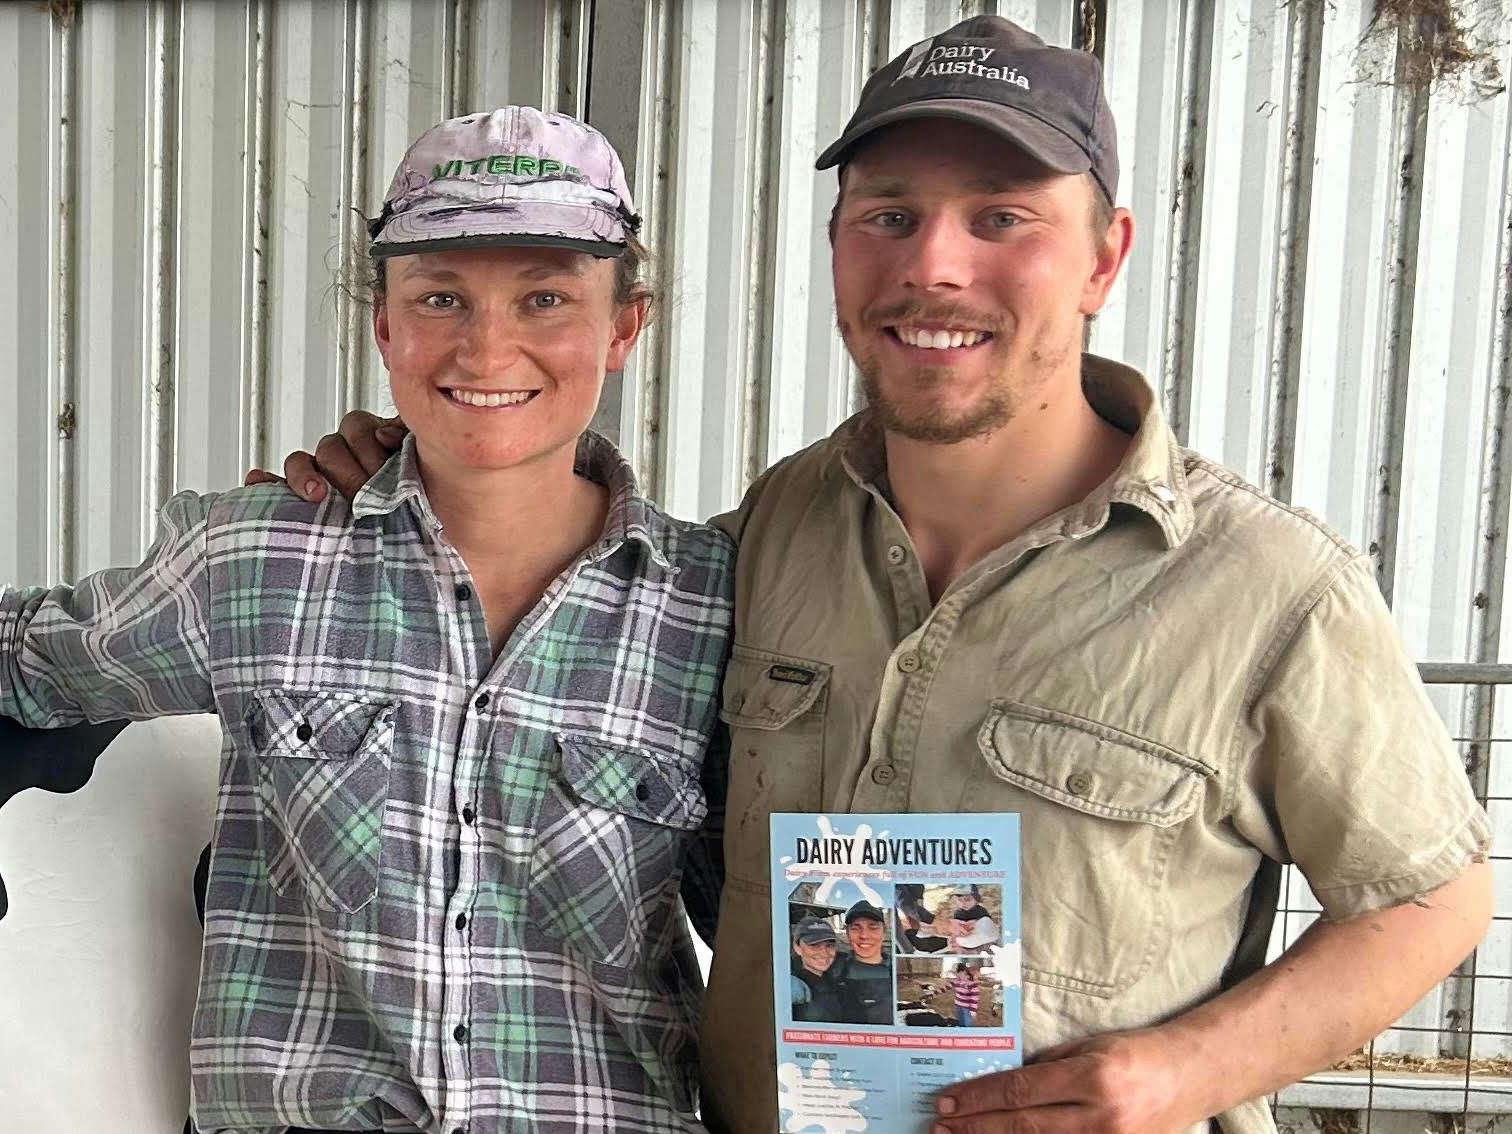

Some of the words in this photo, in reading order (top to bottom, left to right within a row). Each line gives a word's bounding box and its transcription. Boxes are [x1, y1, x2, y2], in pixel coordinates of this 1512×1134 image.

[929, 43, 996, 62] Dairy
[920, 60, 1030, 90] Australia
[796, 838, 855, 865] DAIRY
[861, 838, 993, 866] ADVENTURES
